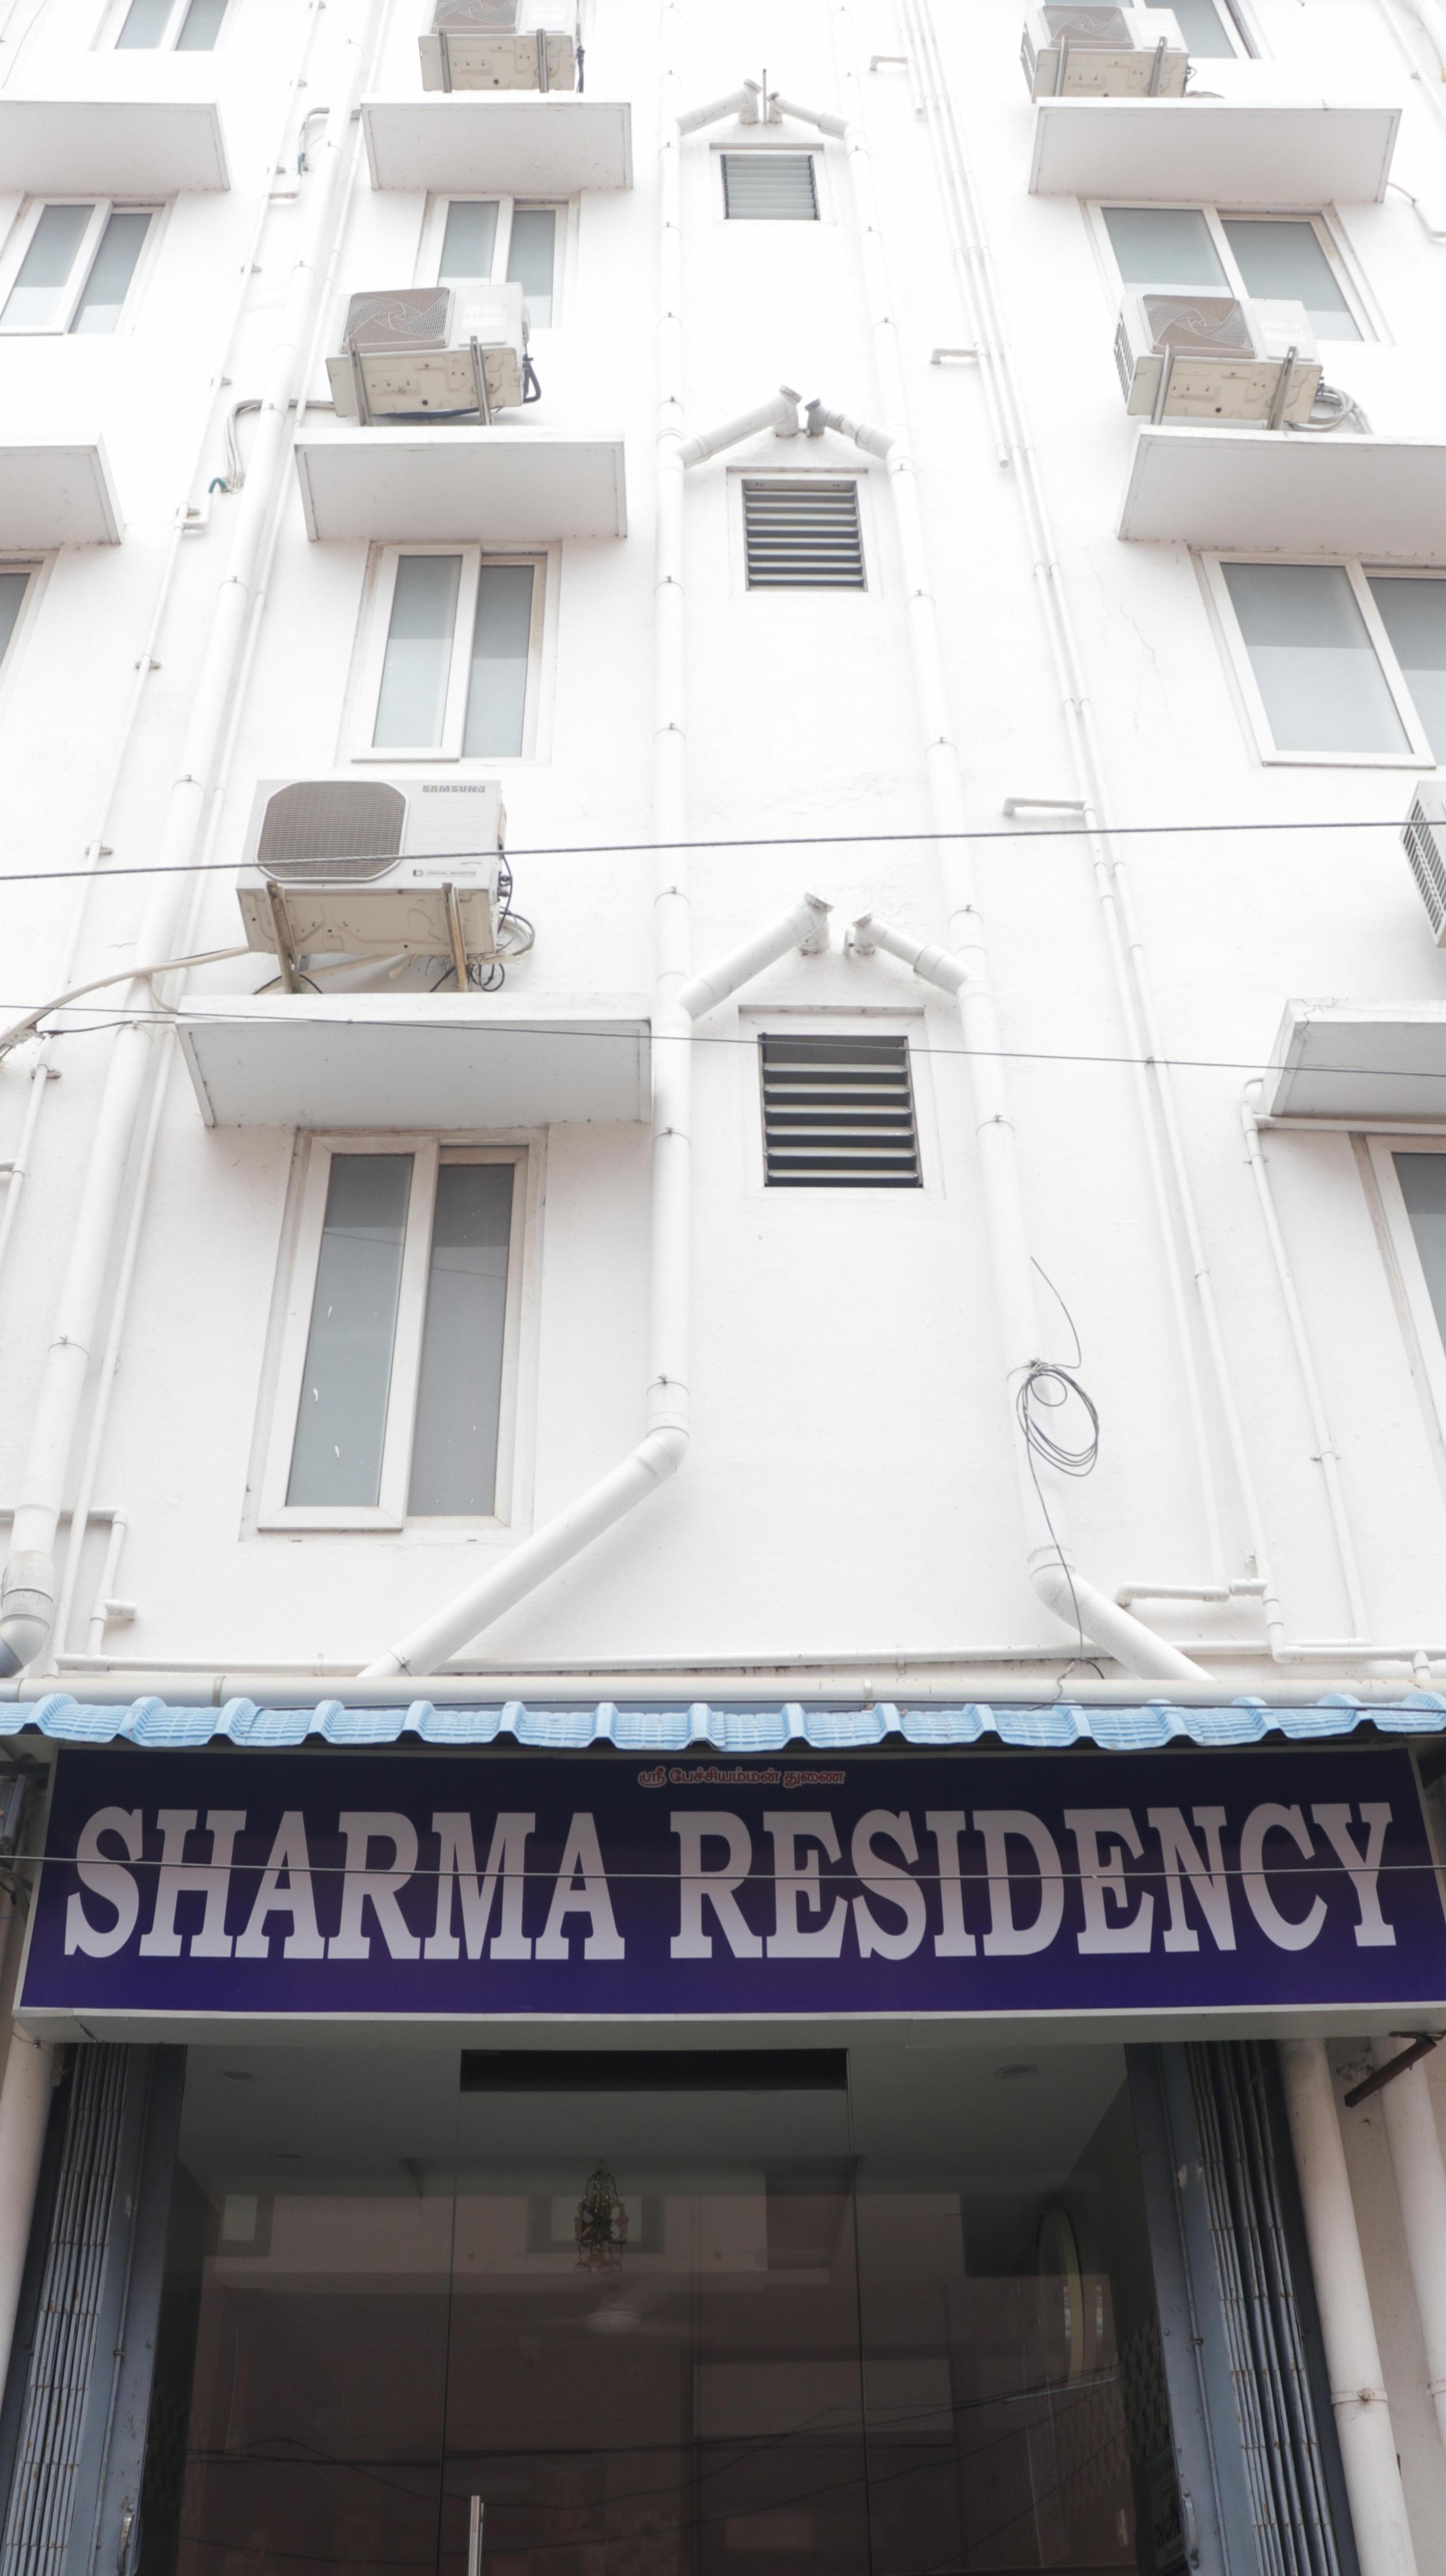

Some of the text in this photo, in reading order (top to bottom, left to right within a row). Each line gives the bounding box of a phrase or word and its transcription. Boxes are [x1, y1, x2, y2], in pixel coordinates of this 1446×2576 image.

[669, 1766, 781, 1784] பேச்சியம்மன்
[783, 1771, 845, 1788] துணை
[65, 1802, 1397, 1961] SHARMA RESIDENCY
